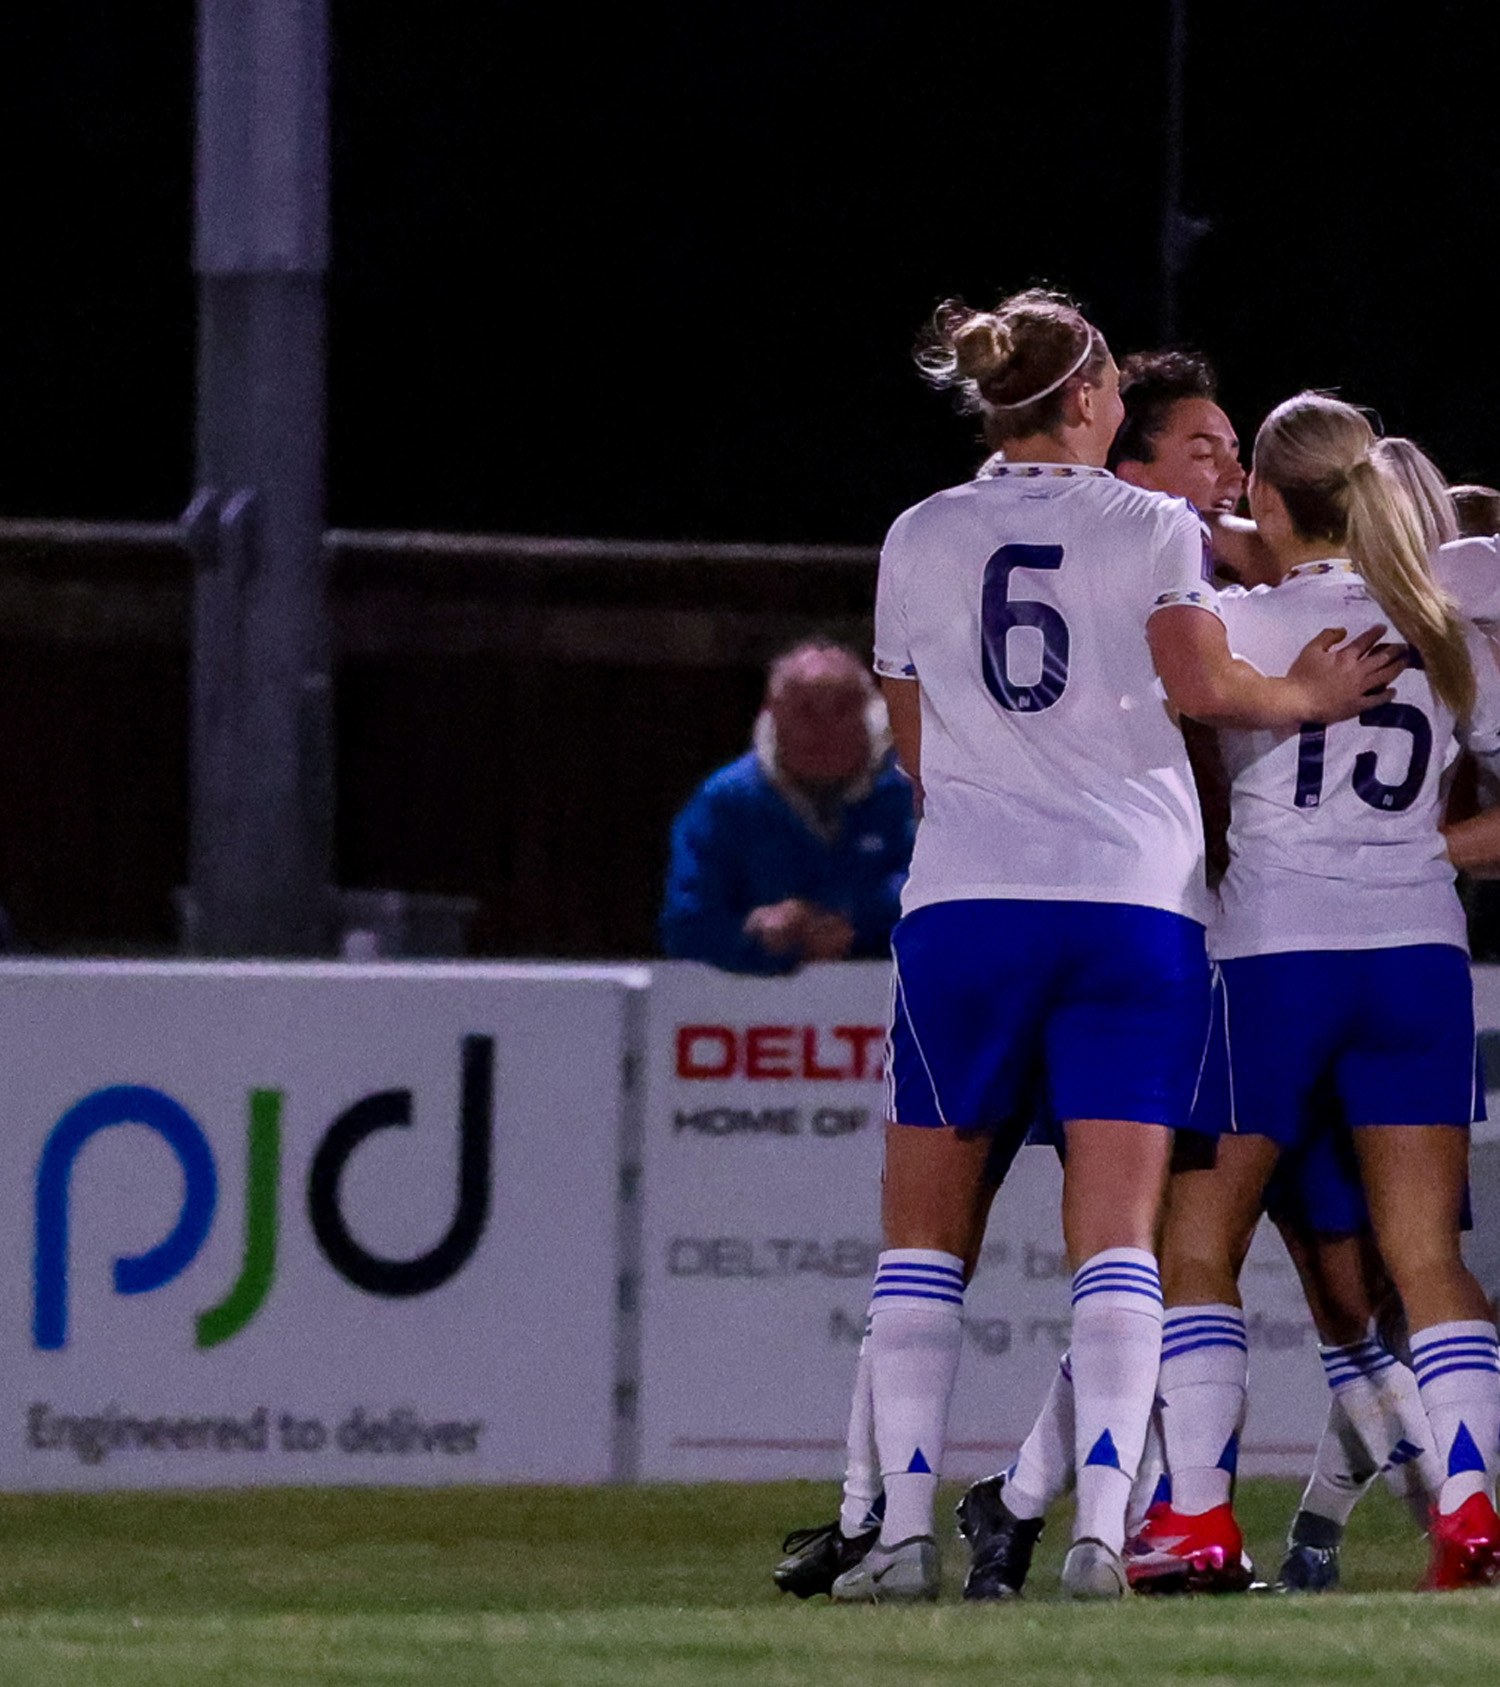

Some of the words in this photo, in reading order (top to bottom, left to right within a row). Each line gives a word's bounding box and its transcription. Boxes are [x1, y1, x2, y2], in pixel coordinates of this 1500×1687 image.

[980, 543, 1072, 713] 6
[674, 1025, 885, 1080] DELT
[673, 1107, 801, 1138] HOME
[811, 1107, 872, 1138] OF
[32, 1034, 494, 1350] pjd
[665, 1236, 883, 1279] DELTAB
[27, 1401, 269, 1465] Engineered
[279, 1409, 328, 1452] to
[336, 1404, 484, 1454] deliver
